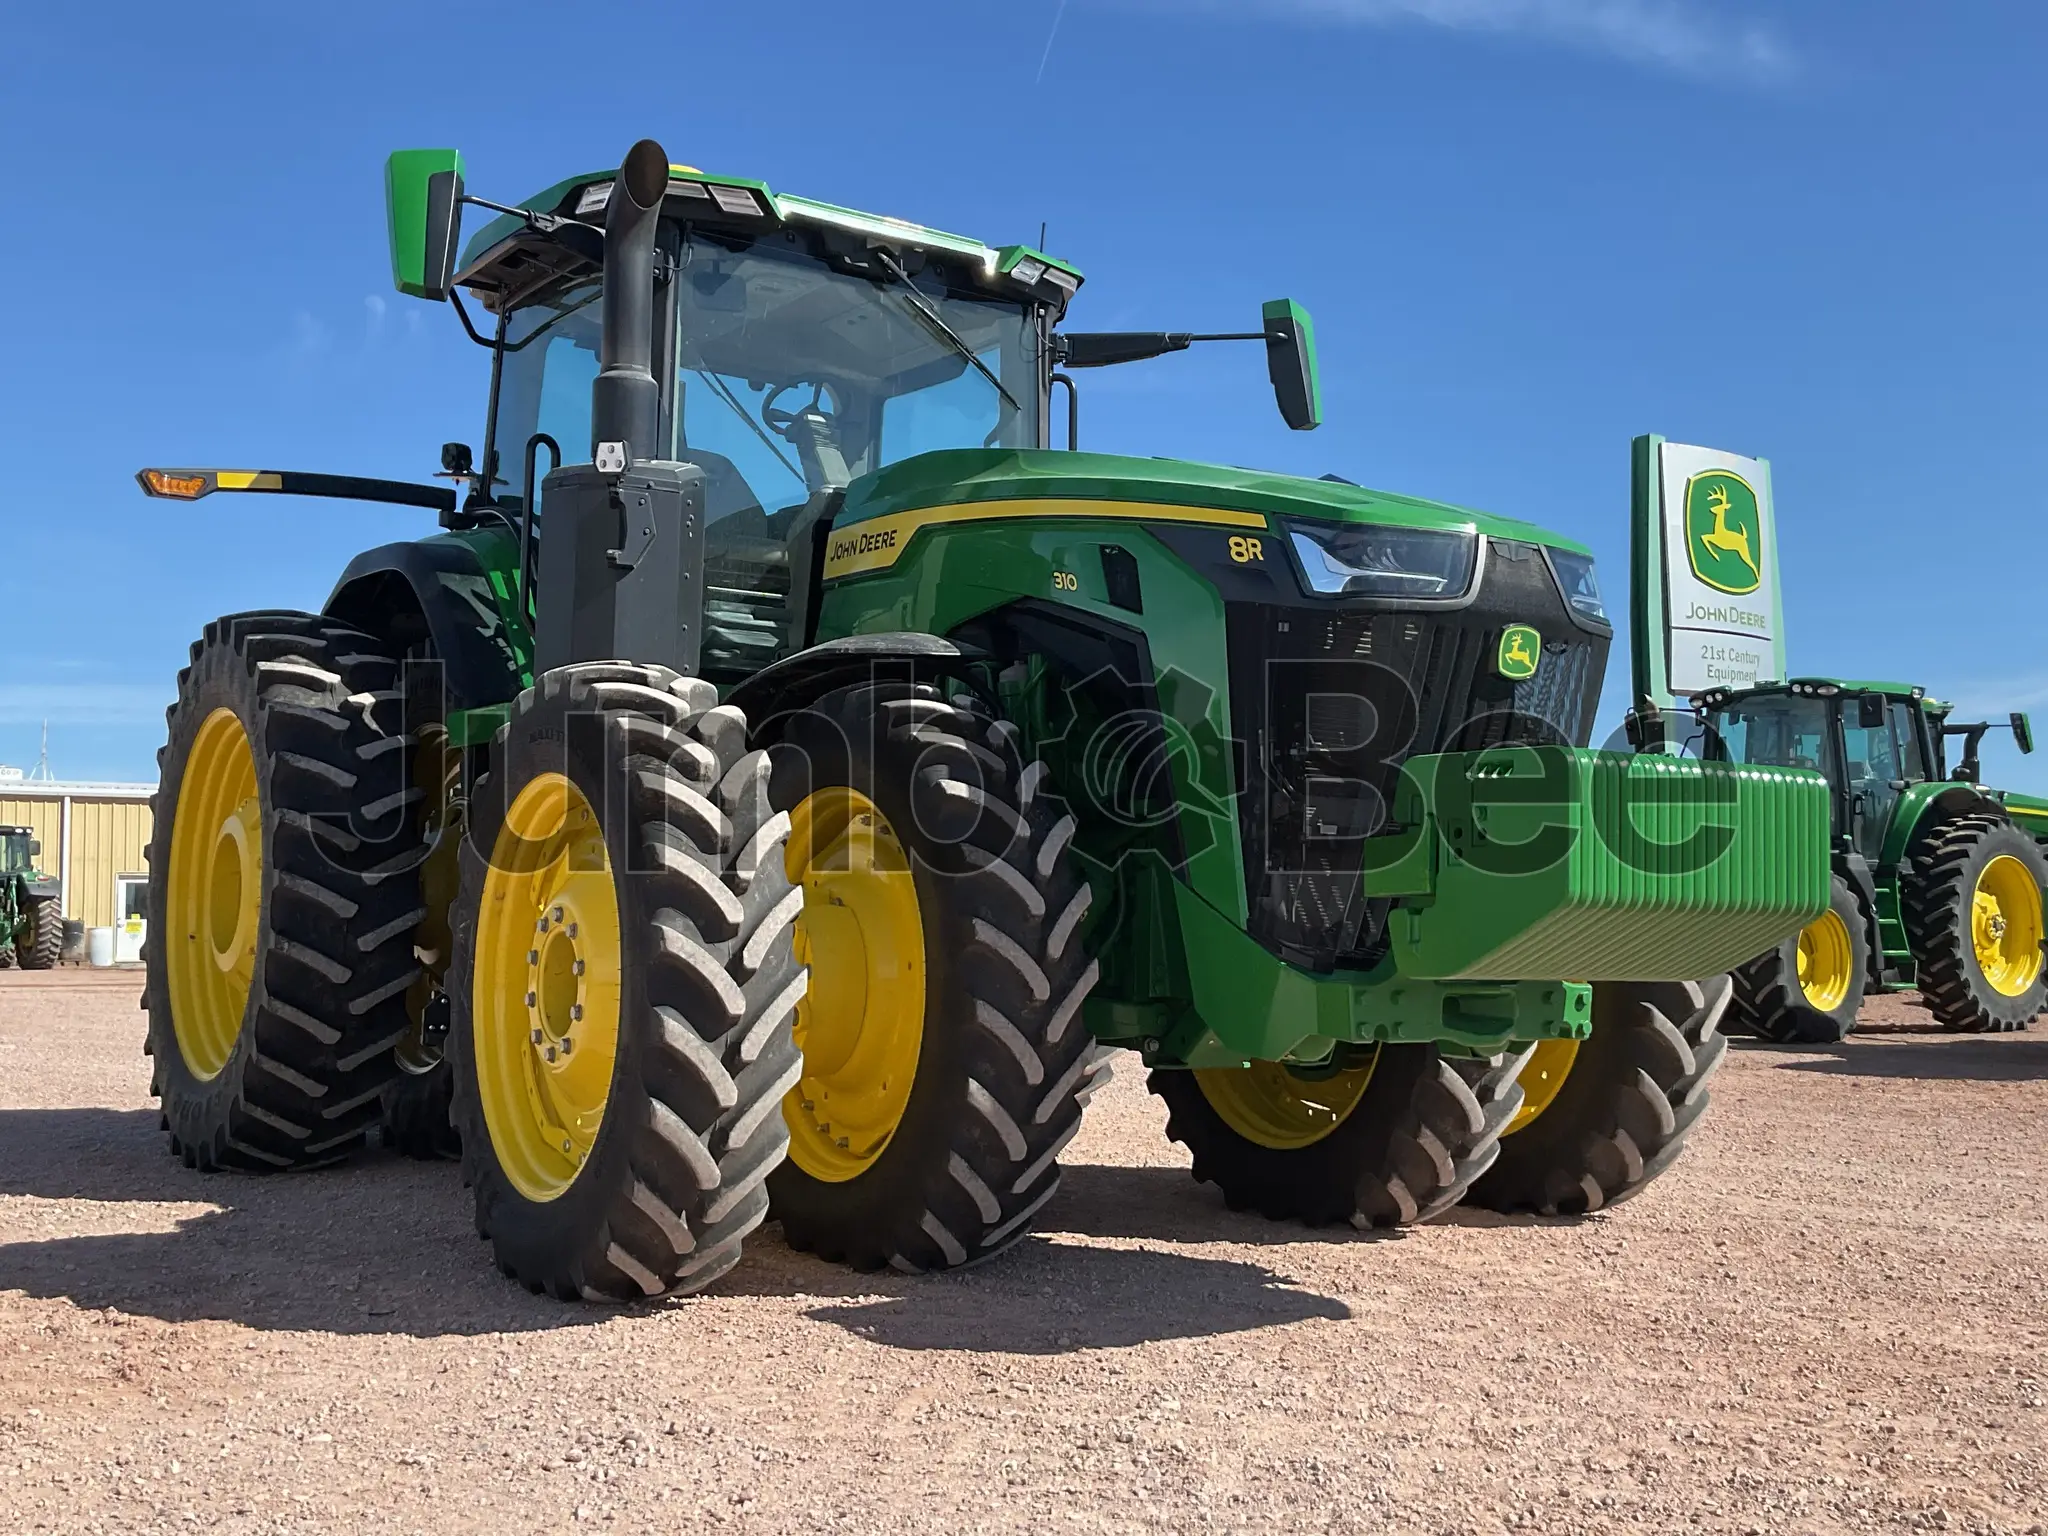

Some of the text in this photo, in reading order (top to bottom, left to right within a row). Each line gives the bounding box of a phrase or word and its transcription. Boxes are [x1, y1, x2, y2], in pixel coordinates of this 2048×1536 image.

[830, 529, 897, 562] JOHN DEERE
[1228, 536, 1264, 563] 8R
[1053, 572, 1078, 591] 310
[1686, 602, 1765, 629] JOHN DEERE
[1701, 645, 1760, 668] 21st Century
[1707, 664, 1757, 683] Equipment
